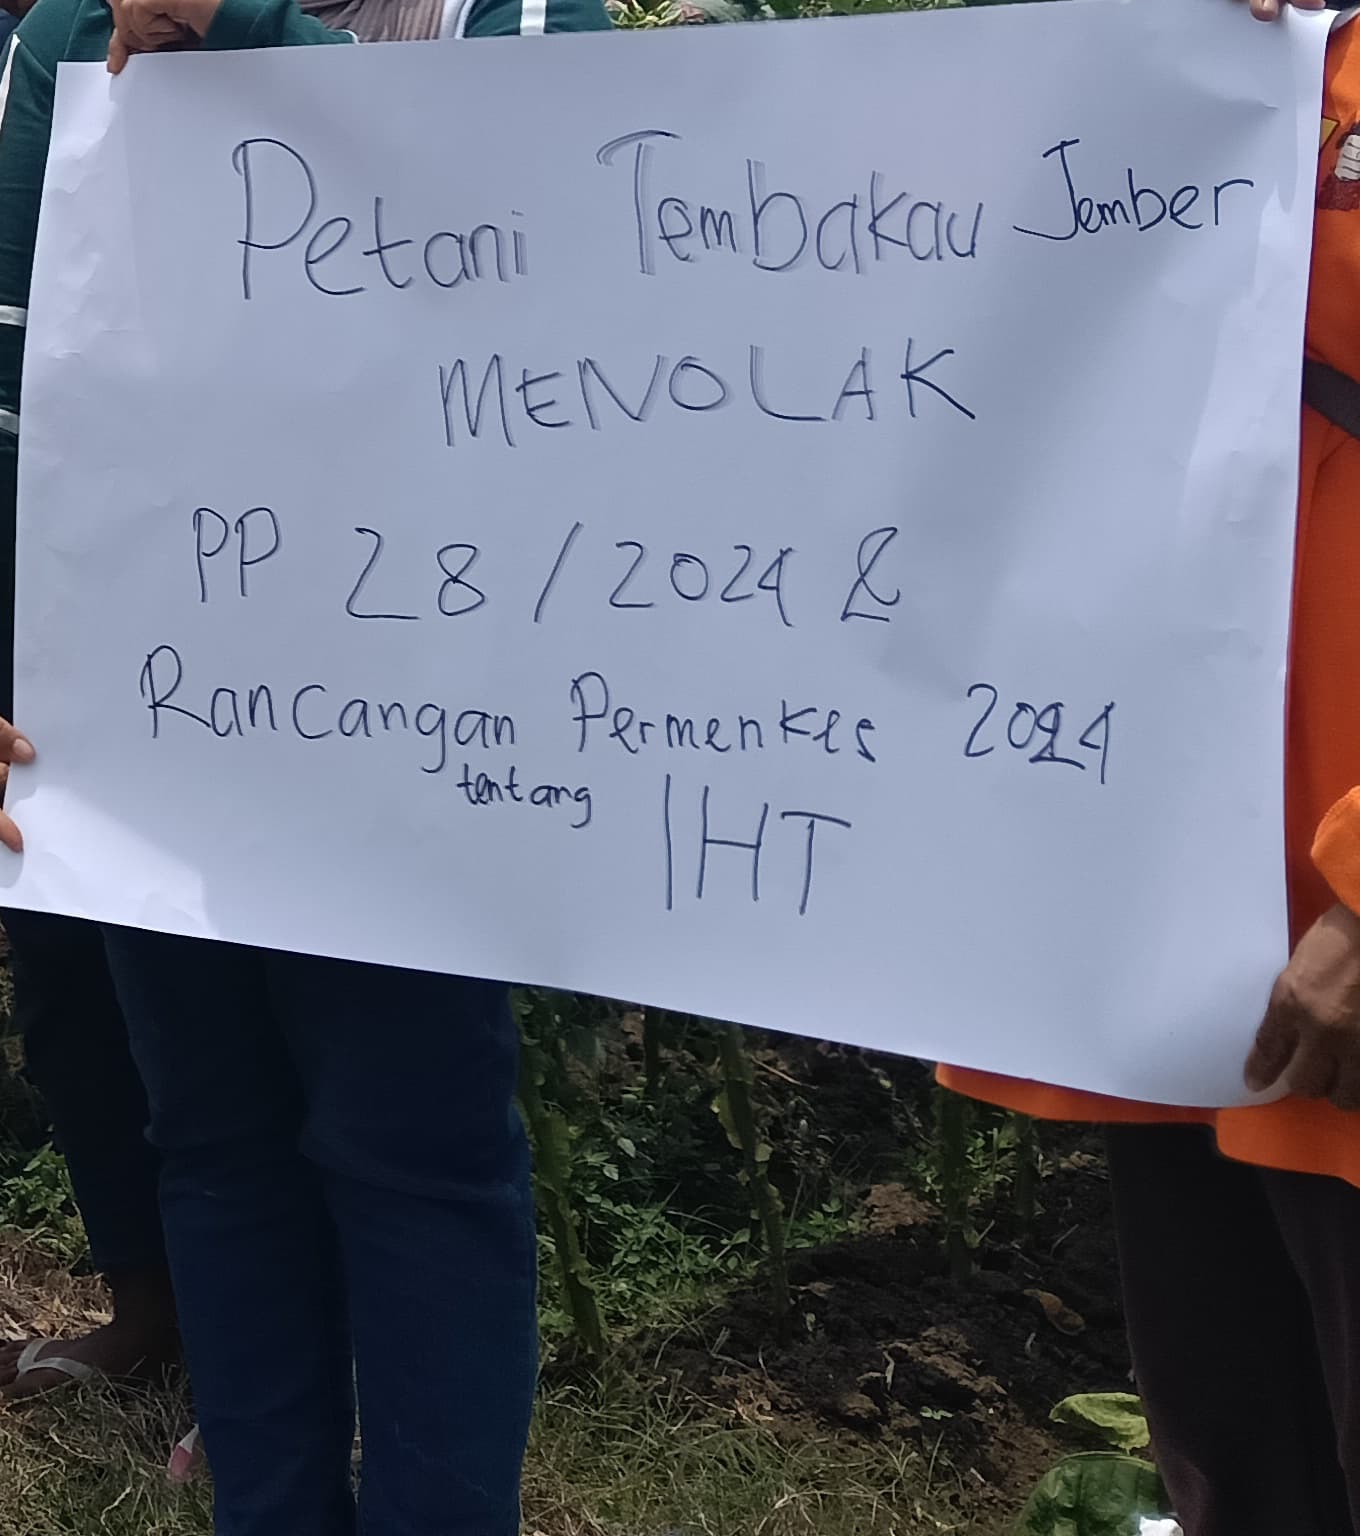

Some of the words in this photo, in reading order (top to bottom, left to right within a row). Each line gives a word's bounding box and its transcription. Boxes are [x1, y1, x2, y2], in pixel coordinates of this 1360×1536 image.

[232, 138, 527, 300] Petani
[596, 130, 983, 275] Tembakau
[1014, 138, 1254, 240] Jember
[439, 338, 976, 448] MENOLAK
[193, 507, 280, 603] PP
[840, 526, 901, 623] &
[140, 645, 516, 773] Rancangan
[570, 671, 876, 763] Permenkes
[456, 763, 592, 829] tentang
[664, 773, 852, 915] IHT
